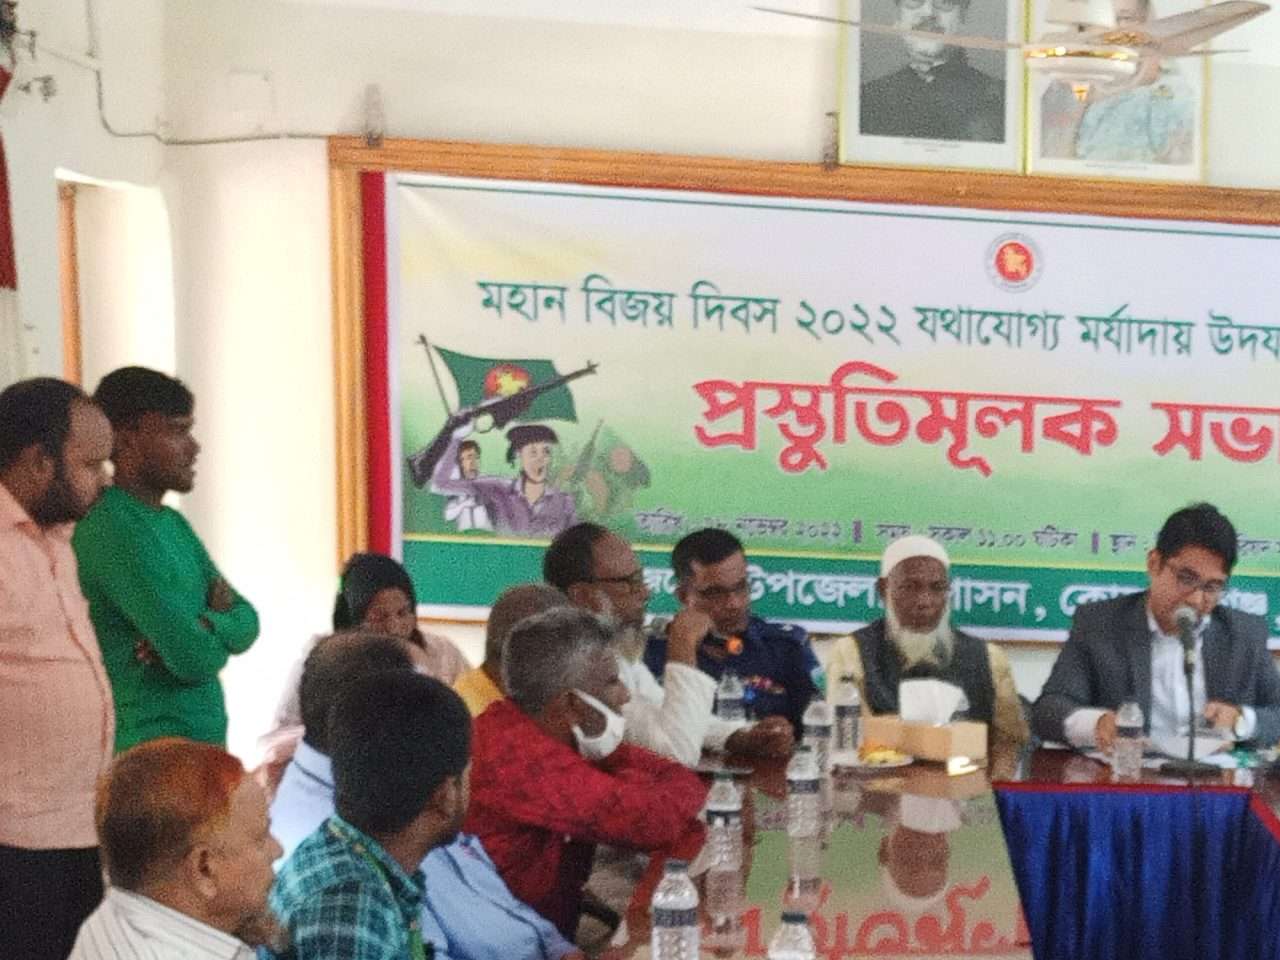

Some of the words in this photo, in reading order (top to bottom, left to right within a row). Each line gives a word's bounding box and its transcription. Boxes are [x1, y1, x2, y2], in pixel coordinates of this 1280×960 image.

[477, 280, 568, 325] মহান
[582, 273, 676, 329] বিজয়
[690, 280, 781, 334] দিবস
[796, 300, 901, 346] ২০২২
[914, 304, 1063, 351] যথাযোগ্য
[1078, 304, 1196, 356] মর্যাদায়
[693, 361, 1120, 475] প্রস্তুতিমূলক
